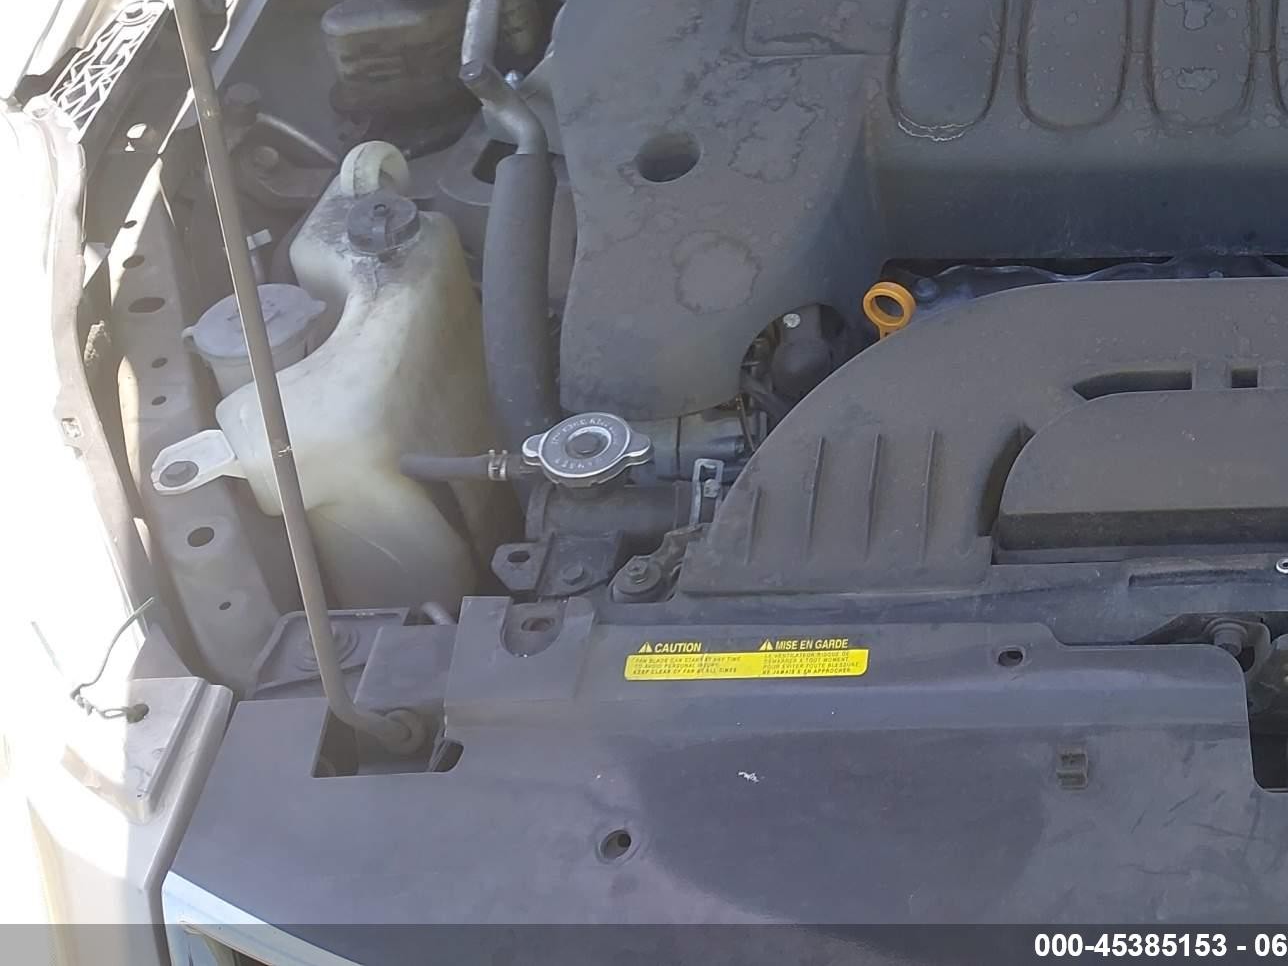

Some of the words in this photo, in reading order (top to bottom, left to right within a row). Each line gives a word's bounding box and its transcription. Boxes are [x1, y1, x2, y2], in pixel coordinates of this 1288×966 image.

[654, 642, 702, 653] CAUTION
[775, 640, 798, 651] MISE
[800, 639, 813, 650] EN
[815, 638, 849, 649] GARDE
